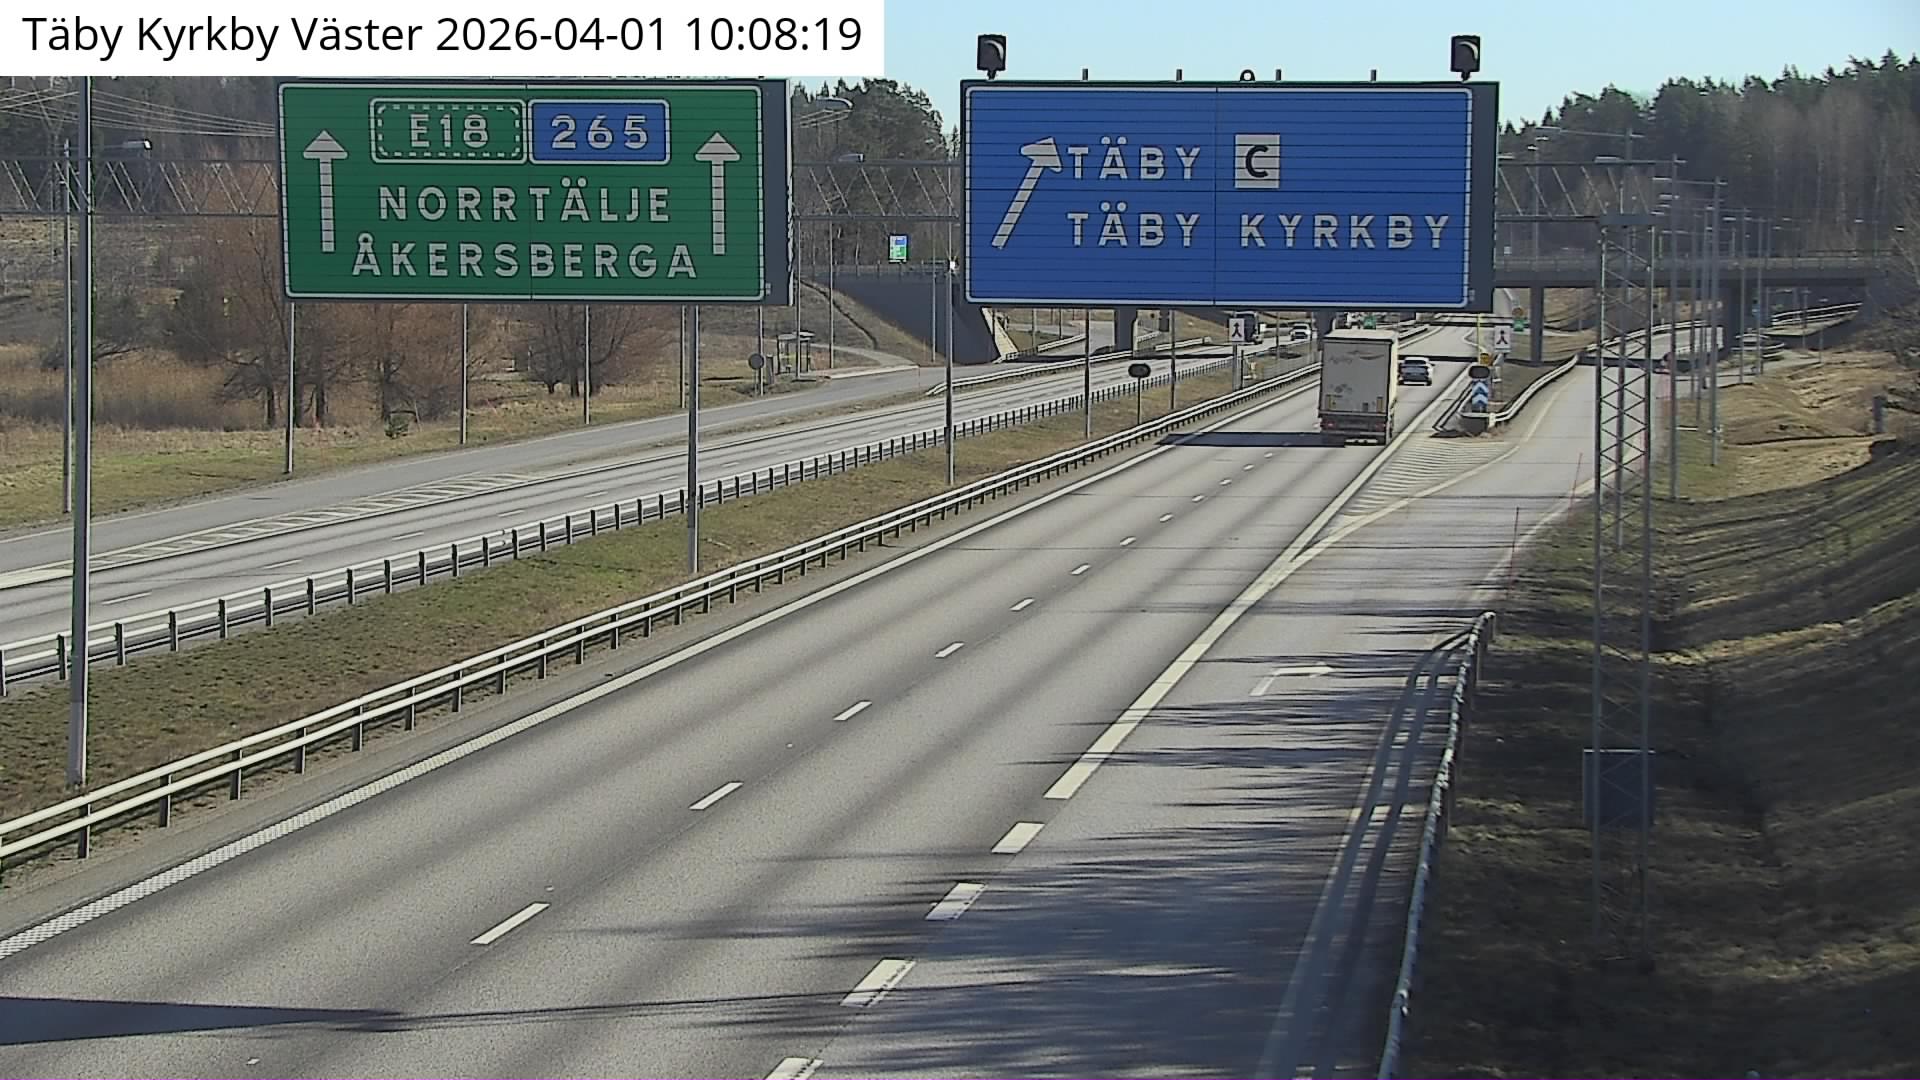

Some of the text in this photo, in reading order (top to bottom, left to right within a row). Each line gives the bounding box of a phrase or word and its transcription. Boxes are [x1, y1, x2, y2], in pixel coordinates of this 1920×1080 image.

[409, 114, 647, 149] E18 265
[1068, 136, 1270, 179] TÄBY C
[380, 177, 669, 222] NORRTÄLJE
[1067, 202, 1449, 248] TÄBY KYRKBY
[352, 233, 696, 278] ÅKERSBERGA
